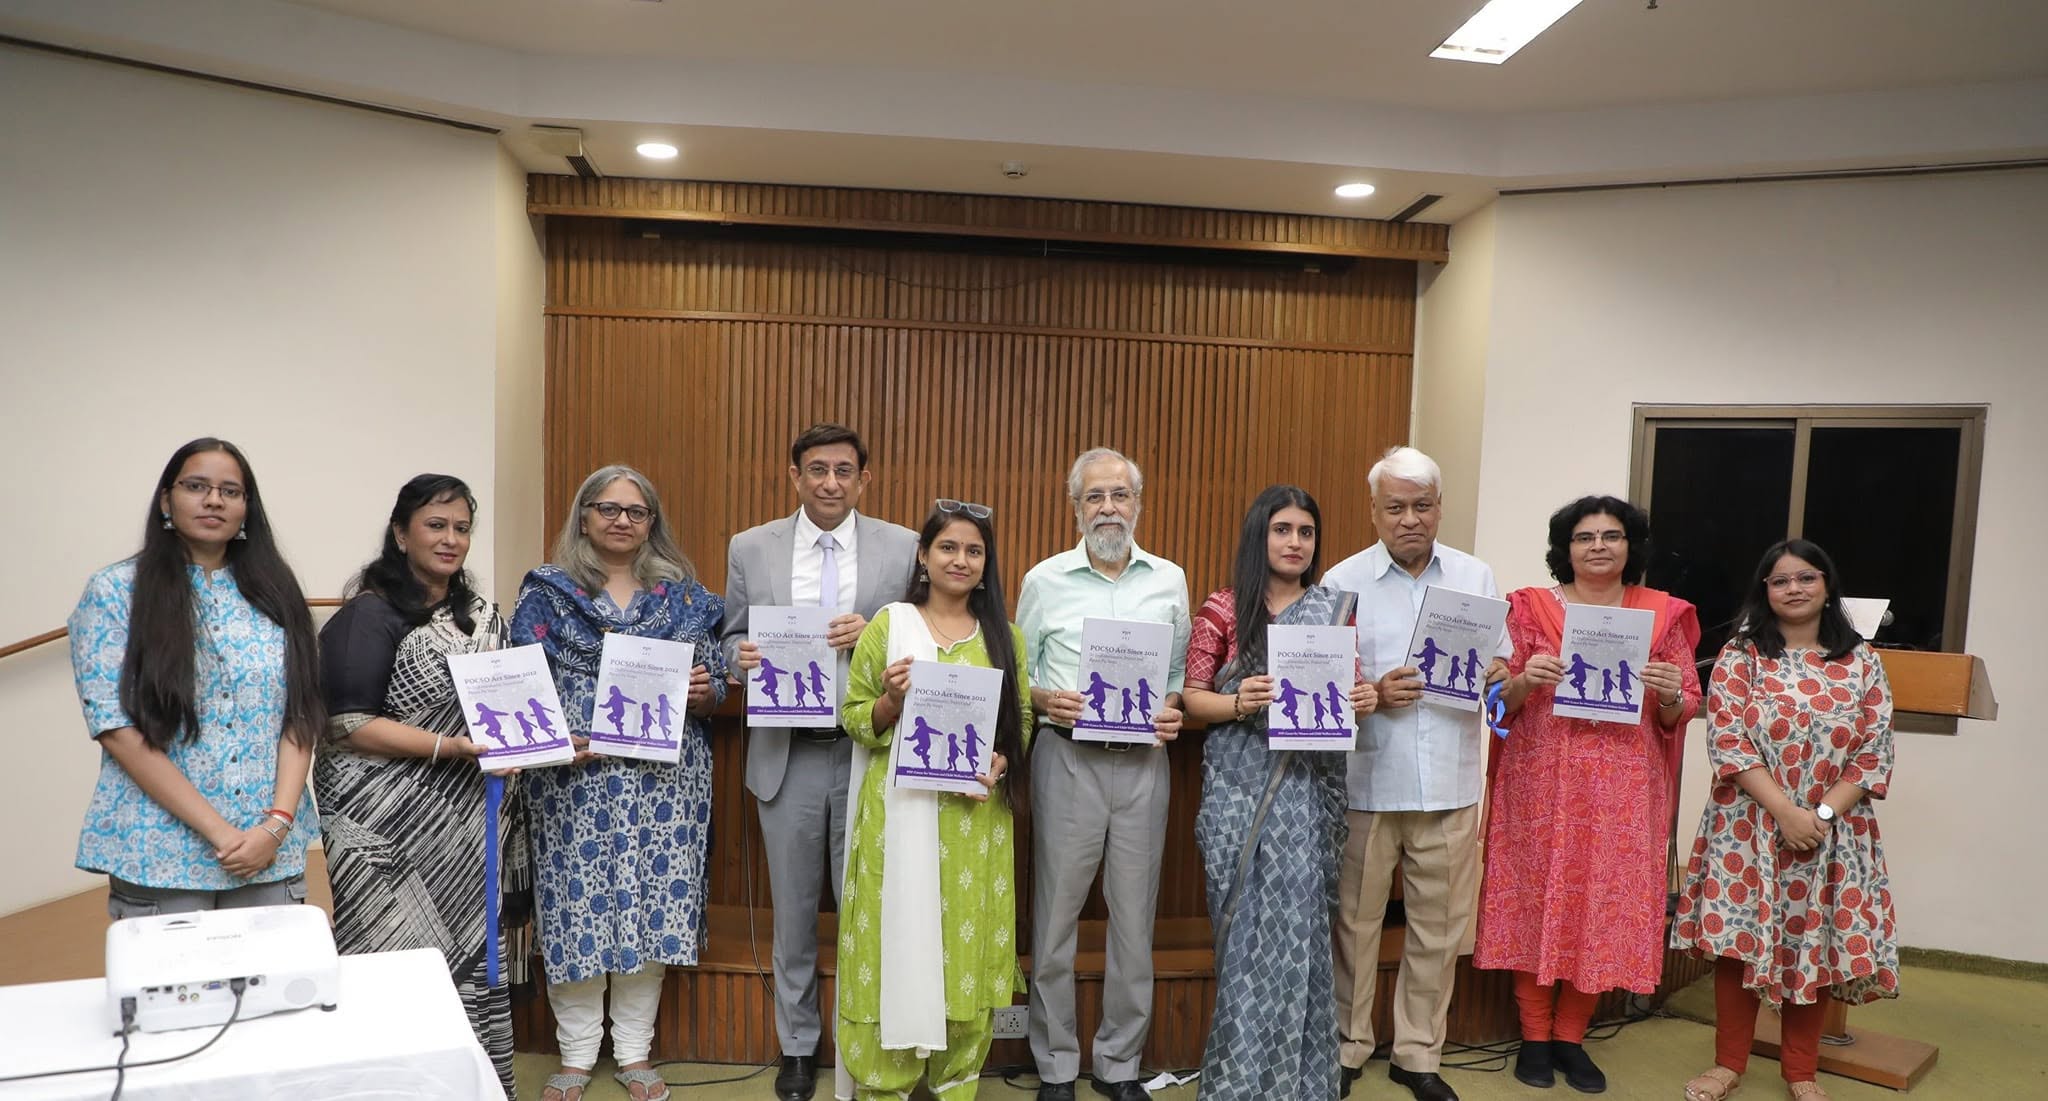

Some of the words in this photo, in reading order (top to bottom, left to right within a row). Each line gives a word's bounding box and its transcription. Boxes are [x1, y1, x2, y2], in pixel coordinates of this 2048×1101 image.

[1572, 628, 1596, 637] POCSO
[1090, 645, 1115, 653] POCSO
[610, 659, 635, 667] POCSO
[915, 687, 941, 697] POCSO
[941, 690, 952, 698] Act
[954, 692, 970, 700] Since
